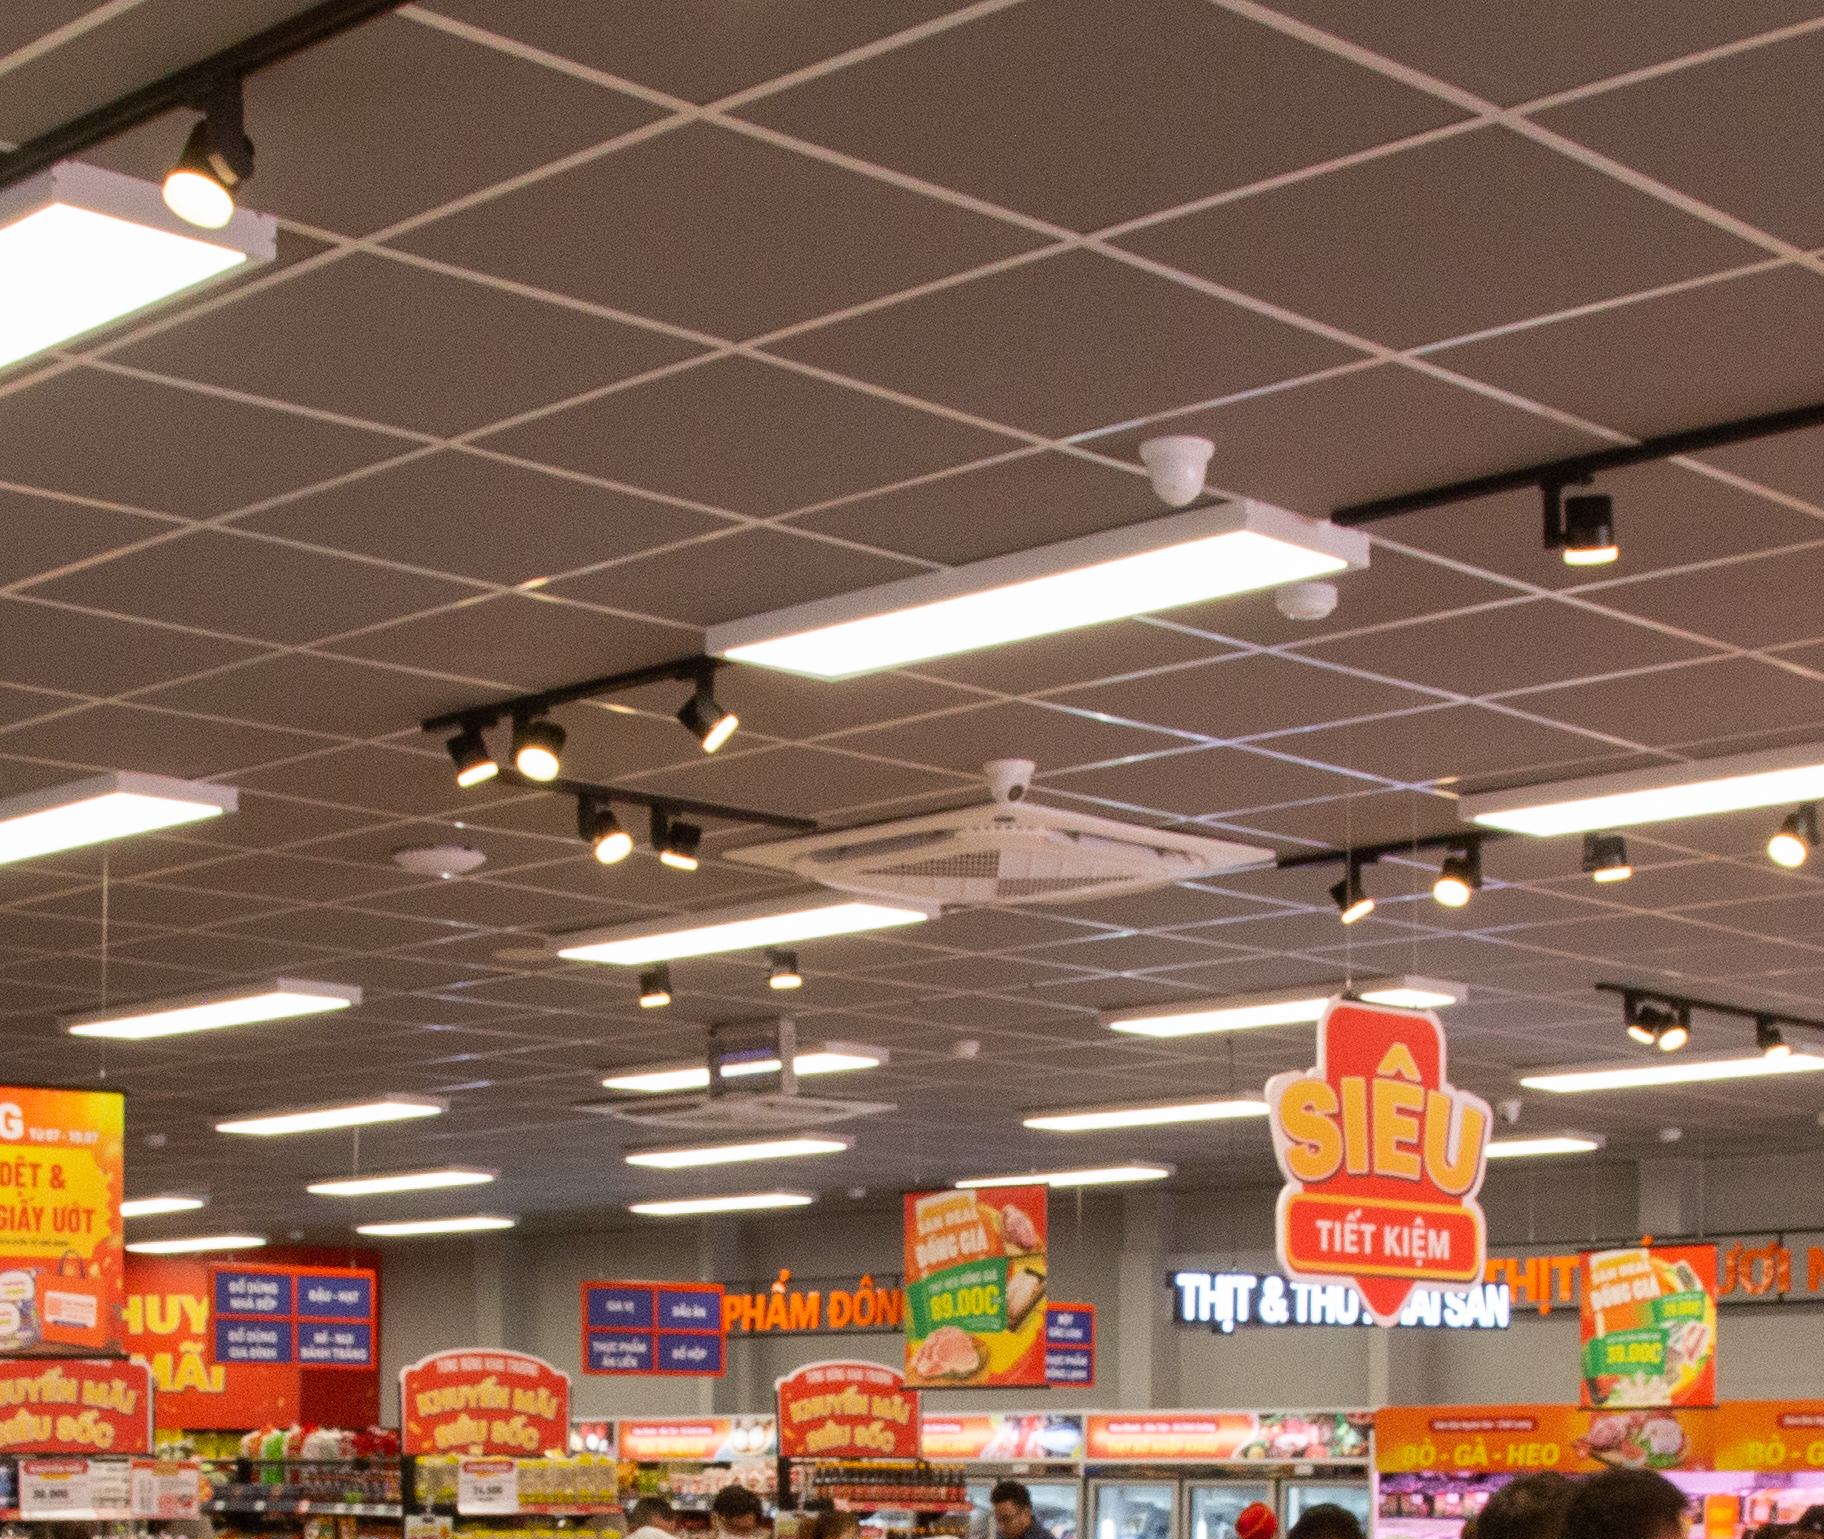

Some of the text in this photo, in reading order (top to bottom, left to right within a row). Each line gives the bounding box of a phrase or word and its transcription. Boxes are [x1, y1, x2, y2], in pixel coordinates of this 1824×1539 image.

[1278, 1042, 1486, 1196] SIÊU
[0, 1157, 42, 1189] DỆT
[49, 1166, 65, 1189] &
[1316, 1209, 1451, 1268] TIẾT KIỆM
[828, 1275, 904, 1328] ĐÔN
[1176, 1272, 1372, 1333] THỊT & THU
[83, 1378, 137, 1416] MÃI
[56, 1411, 114, 1450] SỐC
[1745, 1432, 1787, 1467] BÒ
[1506, 1442, 1560, 1466] HEO
